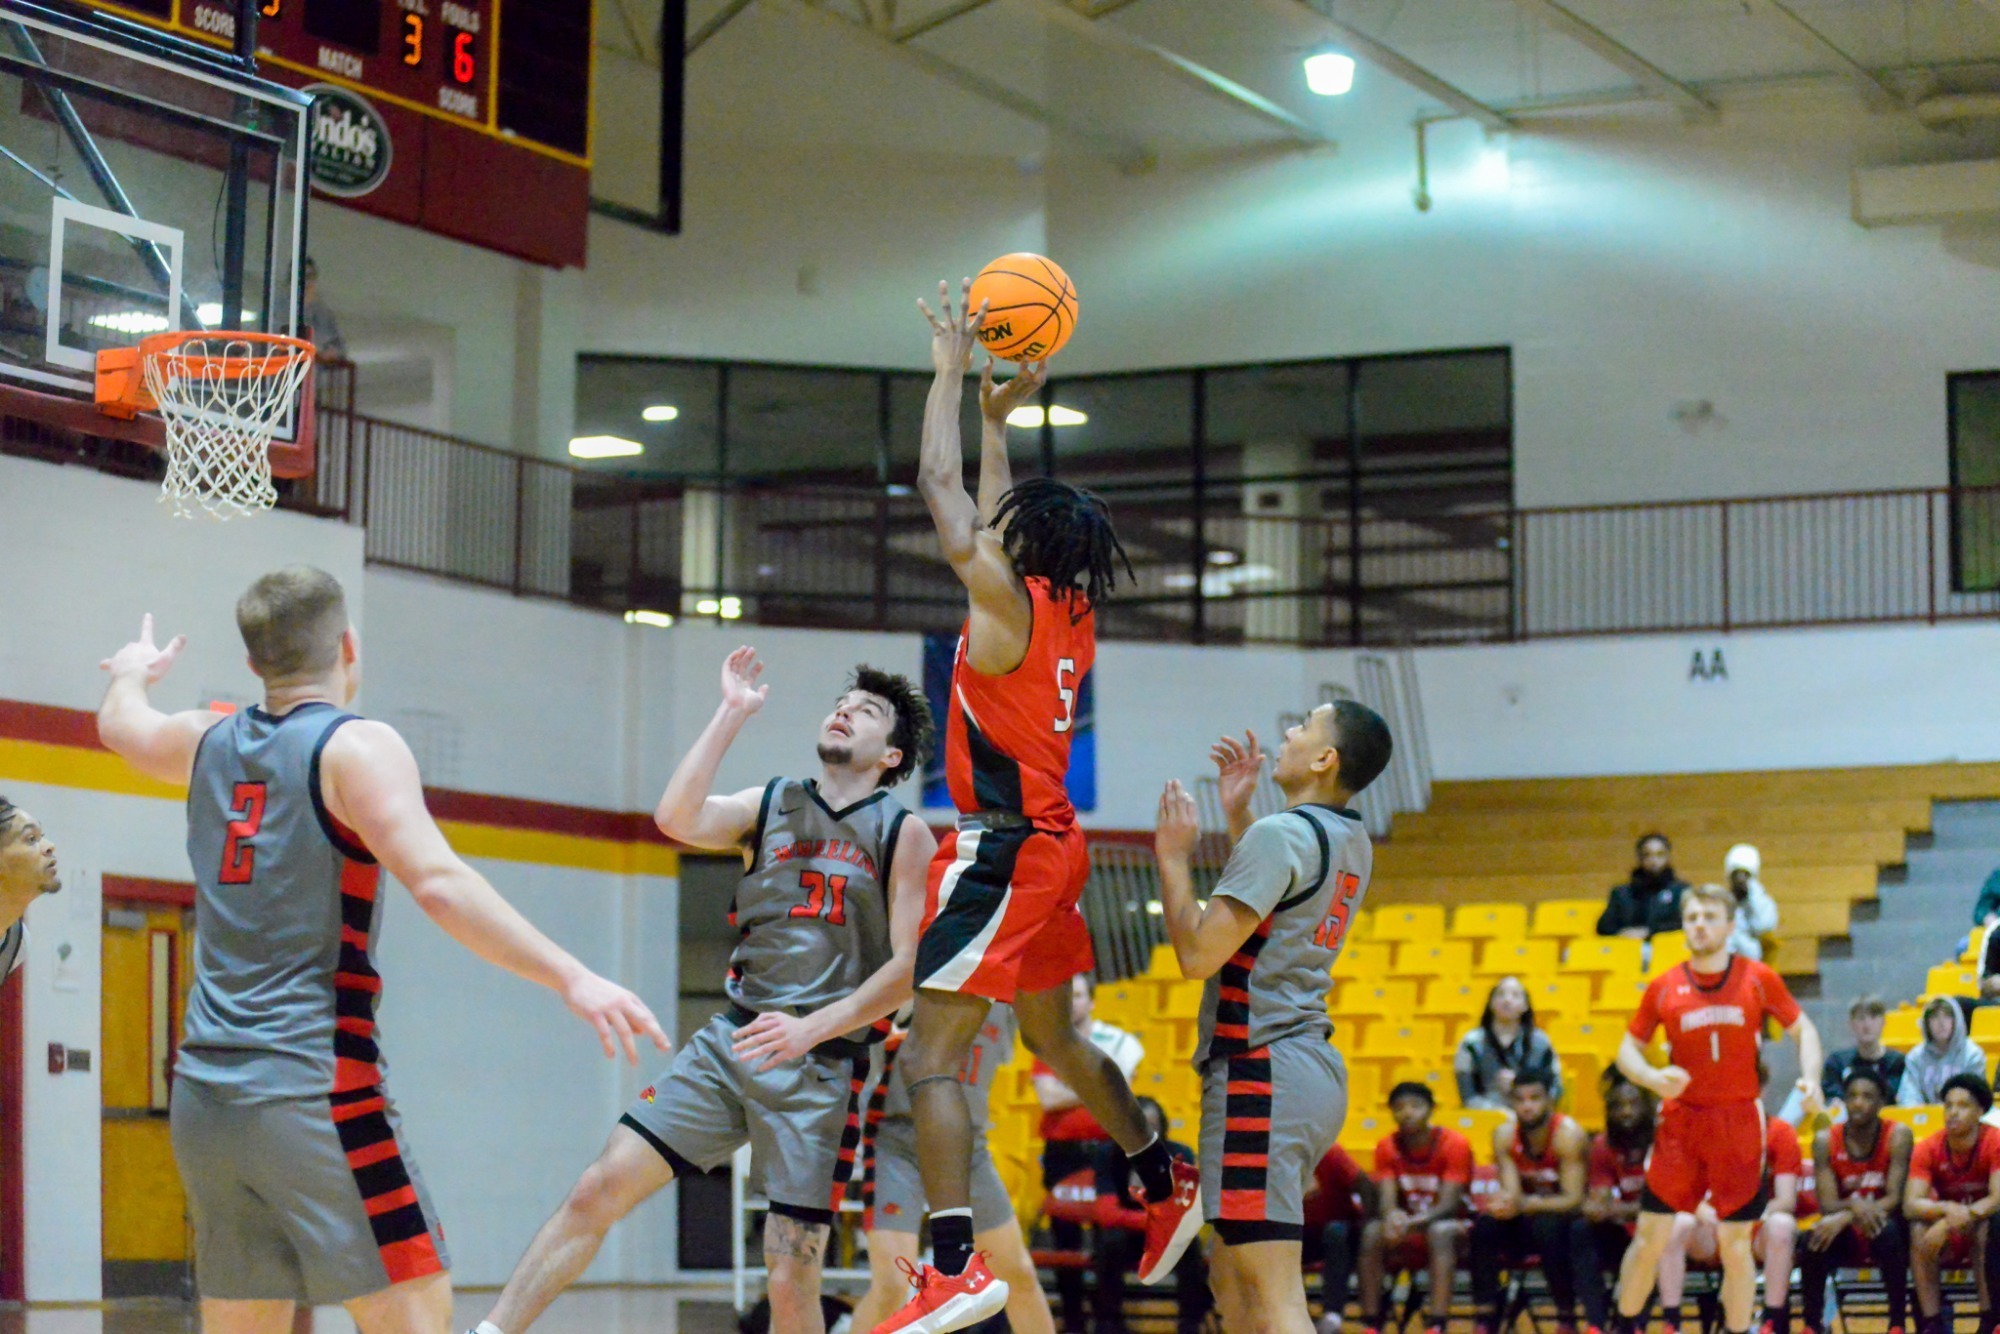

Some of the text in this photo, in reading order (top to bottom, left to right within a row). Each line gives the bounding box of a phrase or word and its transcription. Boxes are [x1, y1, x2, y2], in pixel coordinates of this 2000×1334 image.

[318, 46, 364, 80] MATCH
[404, 13, 423, 65] 3
[454, 32, 474, 83] 6
[1688, 648, 1728, 681] AA
[1053, 657, 1076, 733] 5
[218, 781, 267, 885] 2
[788, 869, 850, 927] 31
[1312, 869, 1360, 951] 15
[1709, 1031, 1721, 1062] 1
